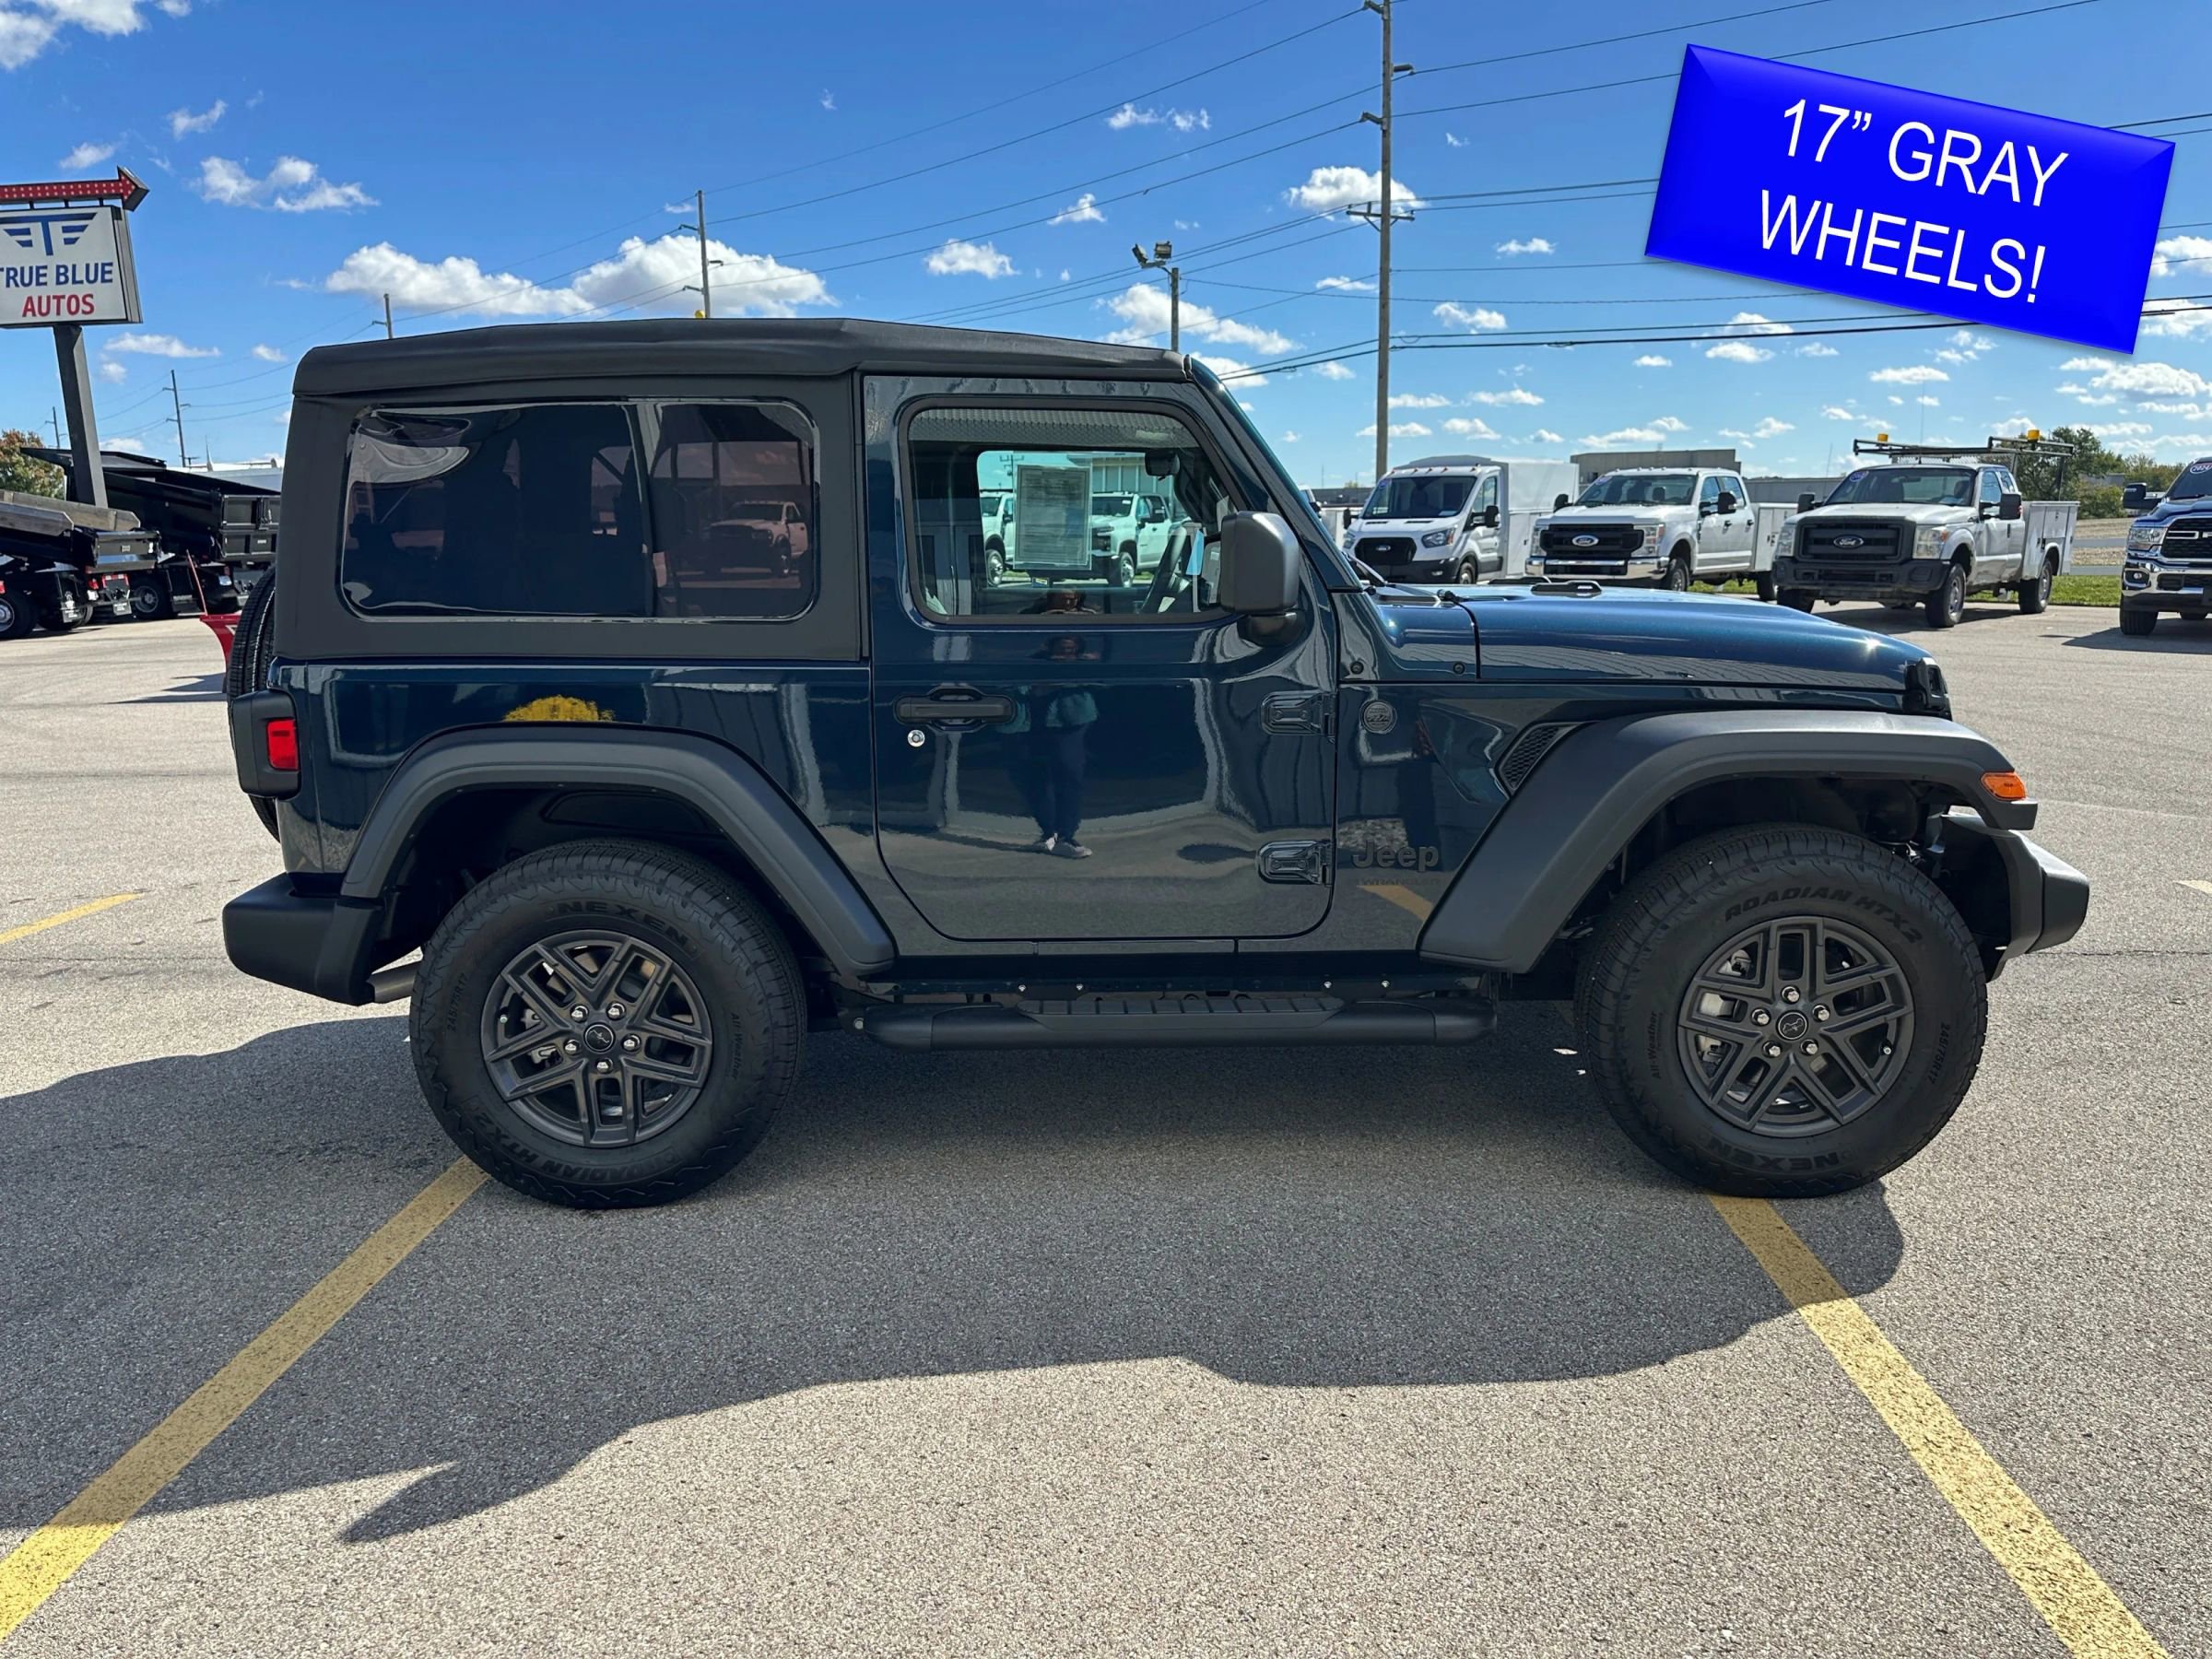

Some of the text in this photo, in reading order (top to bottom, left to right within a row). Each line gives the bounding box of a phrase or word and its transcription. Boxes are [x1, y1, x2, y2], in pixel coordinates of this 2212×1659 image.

[0, 262, 113, 288] RUE BLUE
[22, 294, 95, 317] AUTOS
[1352, 840, 1439, 872] Jeep
[557, 900, 689, 948] NEXEN
[1724, 887, 1924, 944] ROADIAN HTX2
[1707, 1136, 1841, 1171] NEXEN
